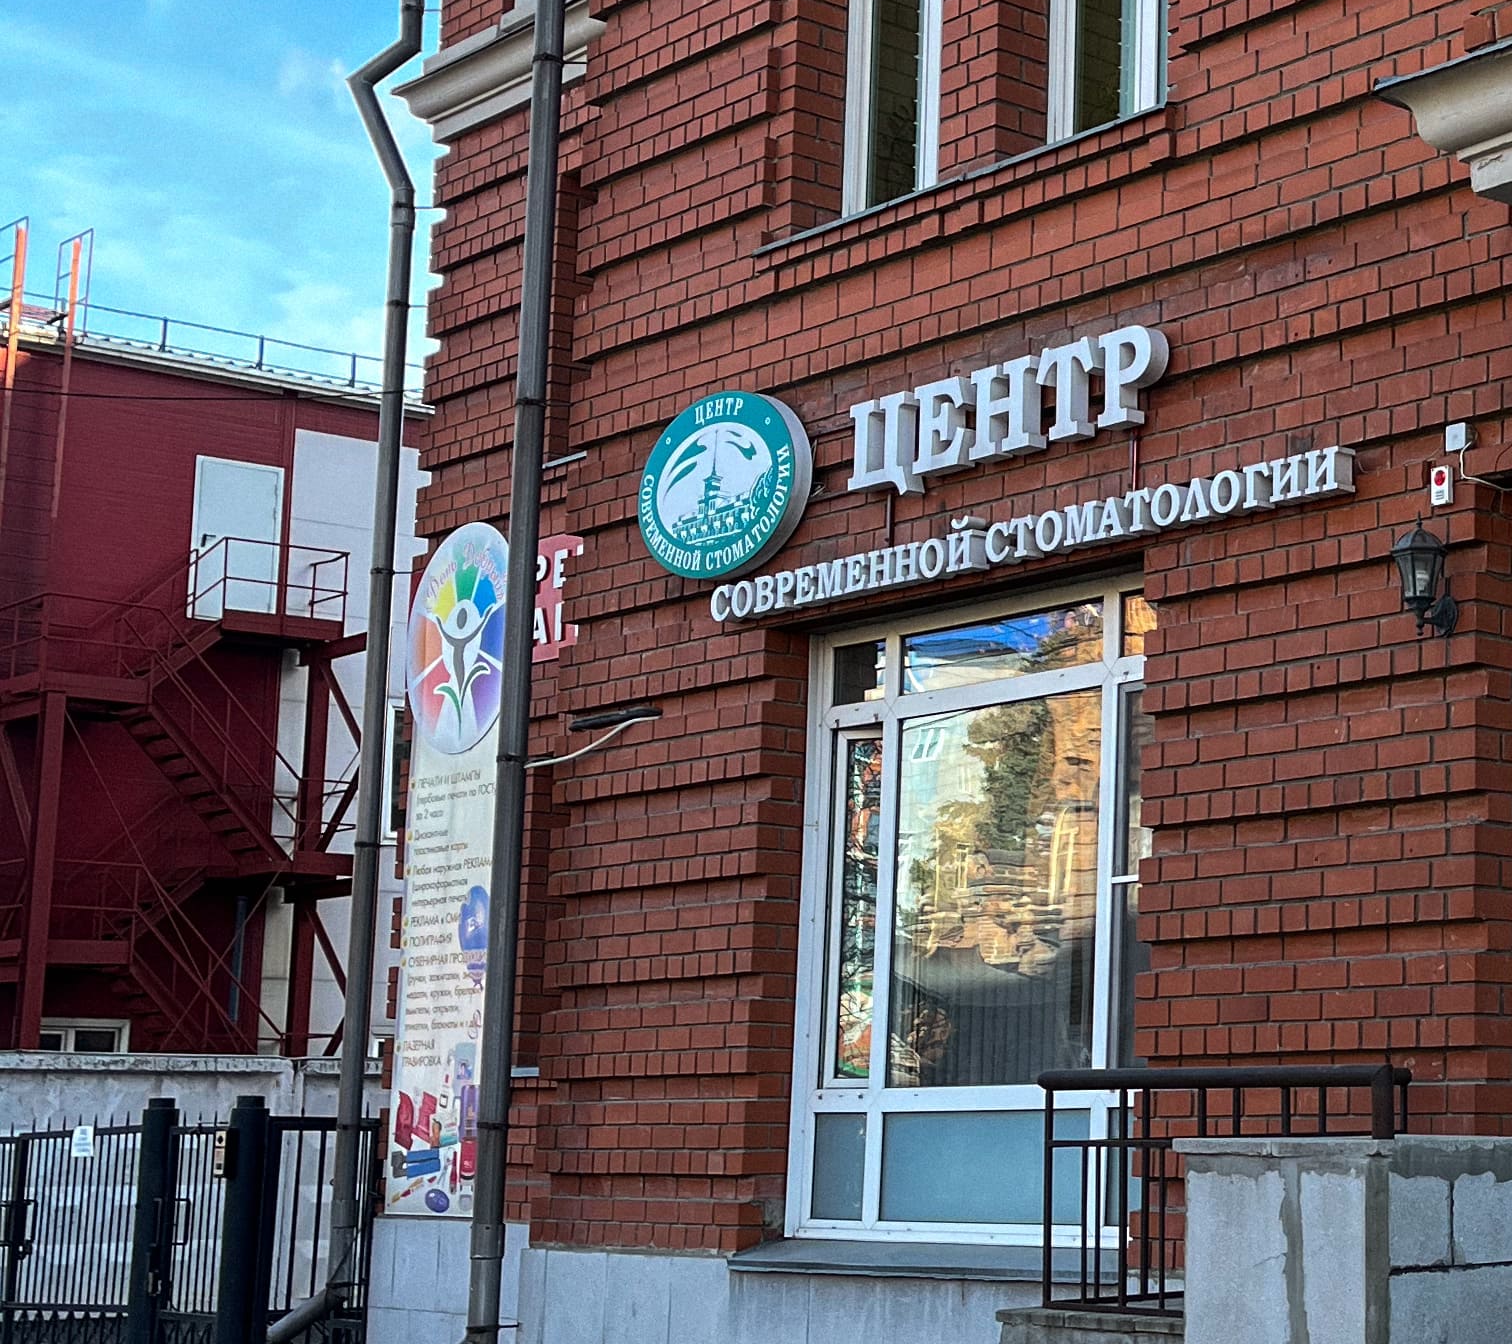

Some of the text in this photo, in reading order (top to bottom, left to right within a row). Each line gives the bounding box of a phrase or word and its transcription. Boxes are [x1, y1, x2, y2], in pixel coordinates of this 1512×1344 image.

[694, 397, 744, 426] ЦЕНТР
[847, 325, 1160, 495] ЦЕНТР
[641, 442, 791, 571] СОВРЕМЕННОЙ СТОМАТОЛОГИИ
[710, 445, 1345, 623] СОВРЕМЕННОЙ СТОМАТОЛОГИИ
